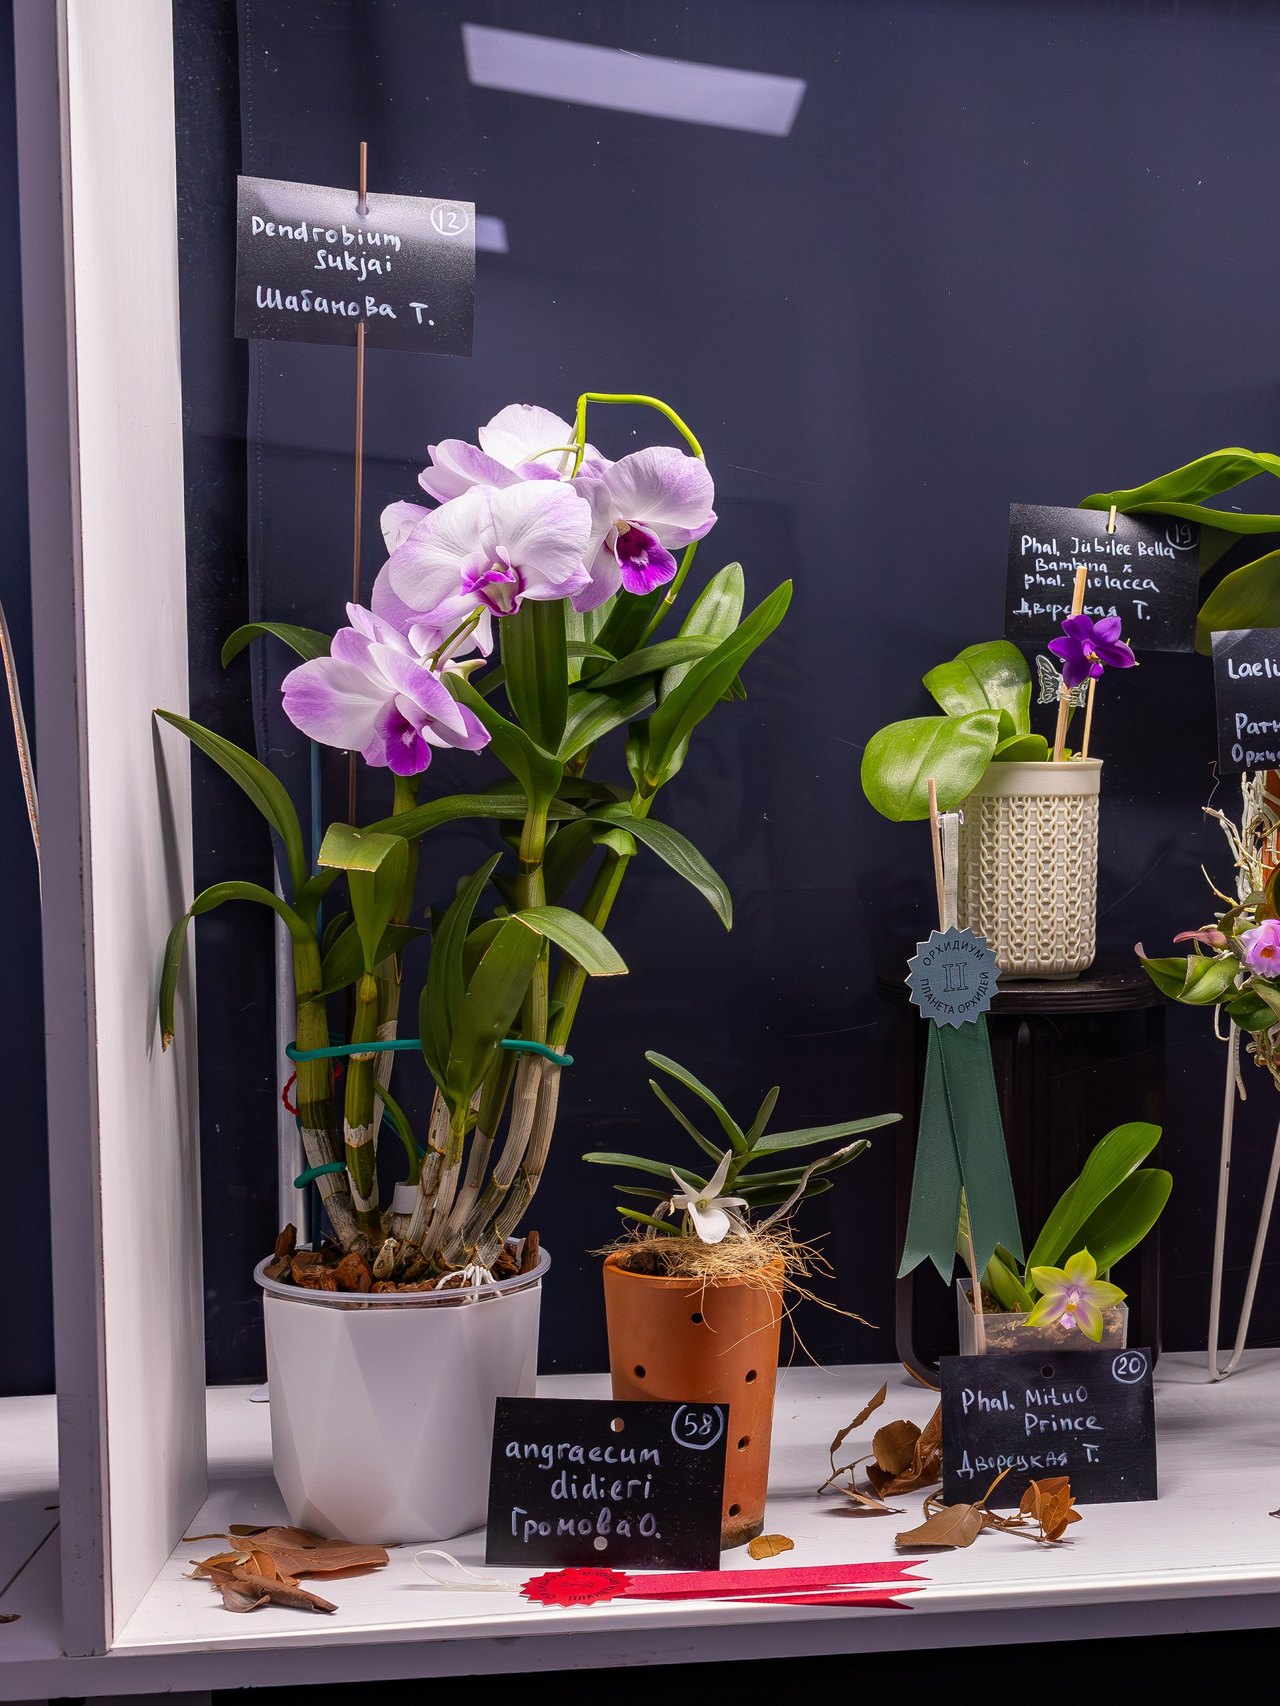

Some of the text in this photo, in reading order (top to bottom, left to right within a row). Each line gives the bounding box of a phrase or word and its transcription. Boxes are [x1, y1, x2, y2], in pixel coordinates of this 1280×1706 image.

[251, 215, 401, 252] Dendrobium
[438, 211, 461, 232] 12
[314, 250, 392, 282] Sukjai
[256, 285, 397, 319] Шабанова
[1175, 523, 1191, 544] 19
[1138, 541, 1175, 559] Bella
[1035, 557, 1108, 573] Bambina
[1024, 574, 1065, 590] phal.
[1012, 598, 1118, 621] Дворекая
[922, 940, 985, 967] ОРХИДИУМ
[941, 962, 969, 993] II
[920, 971, 990, 1015] ПЛАНЕТА ОРХИДЕЙ
[1117, 1356, 1140, 1376] 20
[962, 1388, 1015, 1414] Phal.
[684, 1413, 713, 1436] 58
[1024, 1412, 1104, 1437] Prince
[505, 1441, 661, 1470] angraecum
[550, 1470, 653, 1500] didieri
[511, 1506, 632, 1543] Громова
